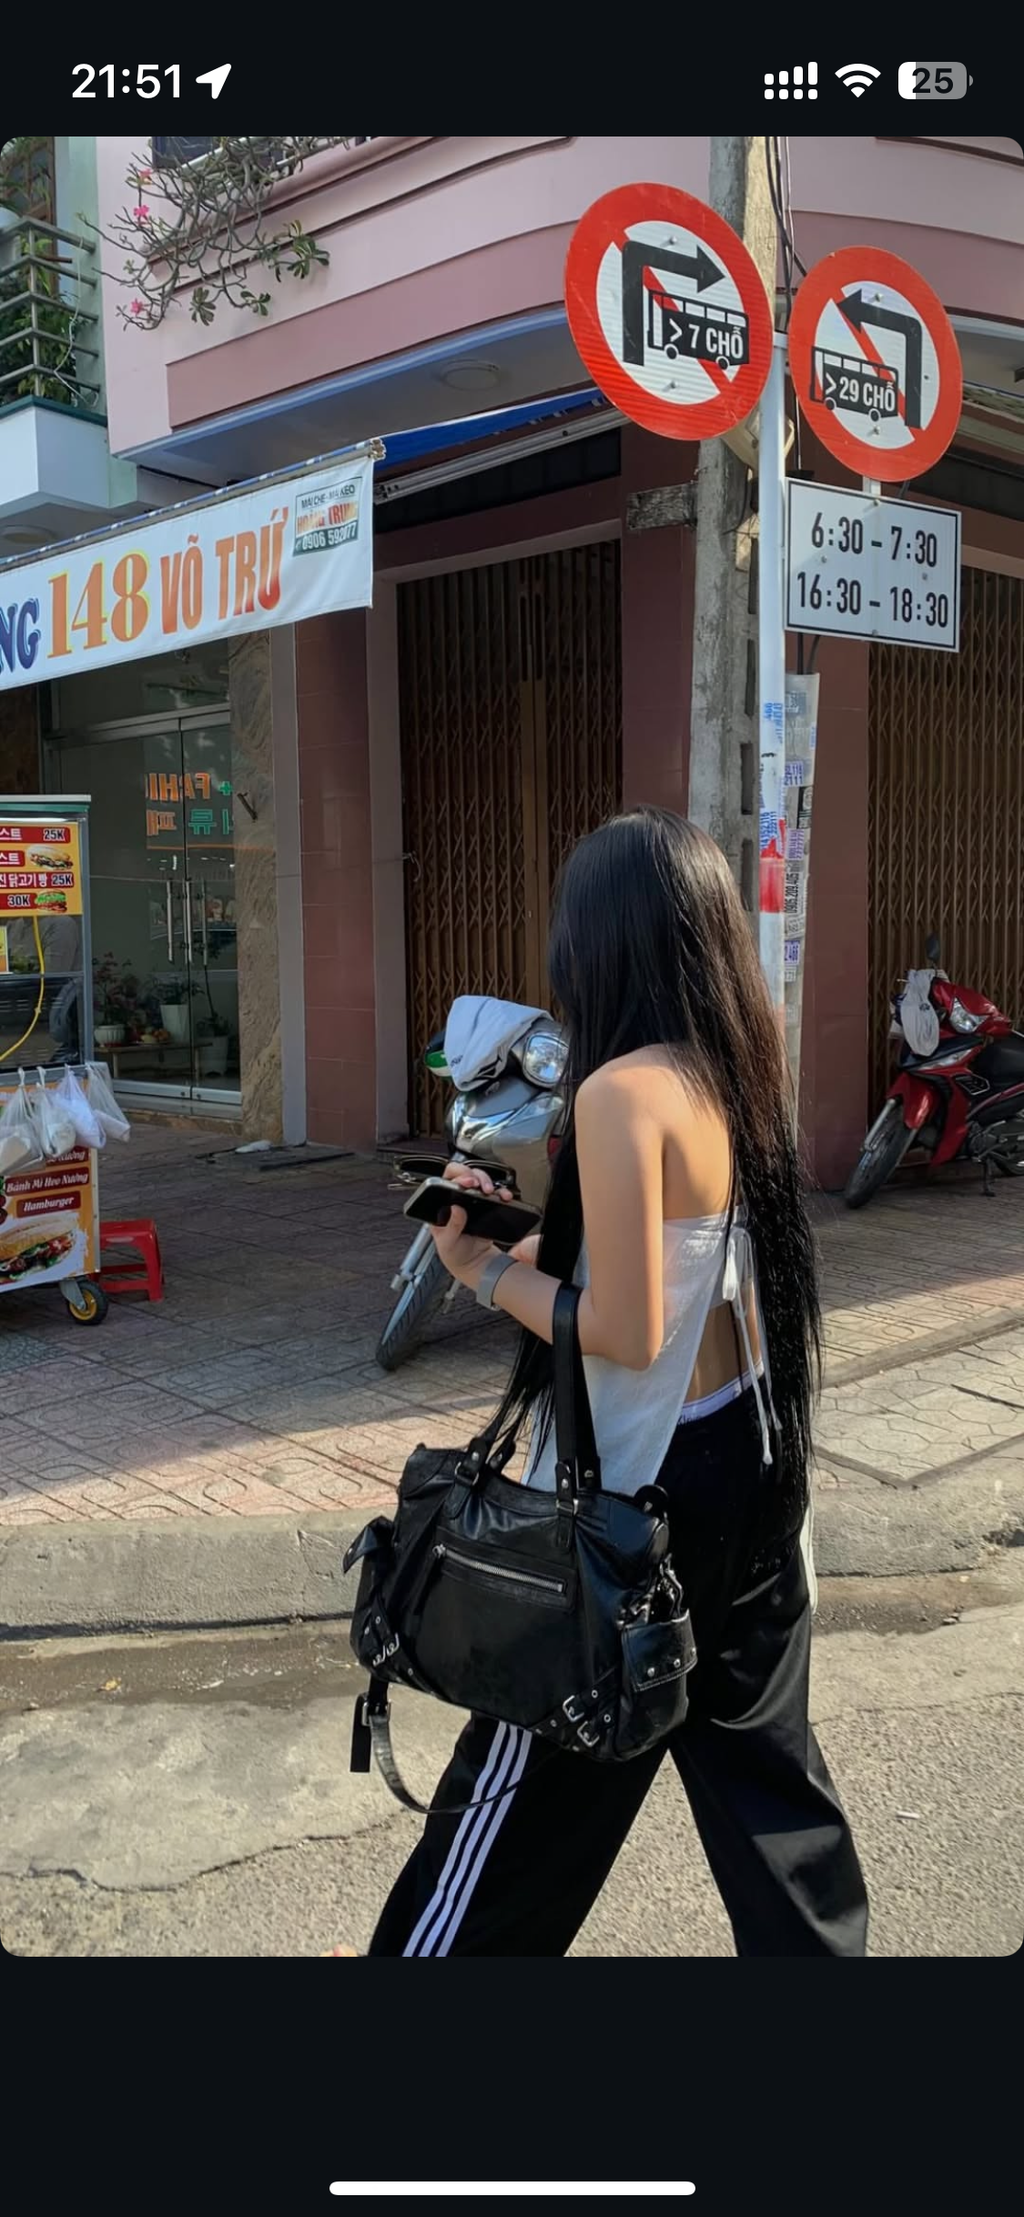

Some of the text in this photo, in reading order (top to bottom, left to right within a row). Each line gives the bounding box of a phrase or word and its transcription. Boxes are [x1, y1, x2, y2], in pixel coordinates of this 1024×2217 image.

[689, 322, 700, 349] 7
[706, 325, 743, 359] CHỖ
[840, 376, 859, 401] 29
[863, 381, 895, 412] CHỖ
[812, 512, 863, 555] 6:30
[891, 525, 937, 567] 7:30
[48, 551, 150, 658] 148
[160, 534, 203, 634] VÕ
[215, 506, 288, 620] TRỨ
[797, 572, 861, 615] 16:30
[890, 586, 948, 628] 18:30
[43, 828, 66, 841] 25K
[51, 874, 73, 886] 25K
[7, 895, 30, 907] 30K
[23, 1197, 75, 1212] Hamburger
